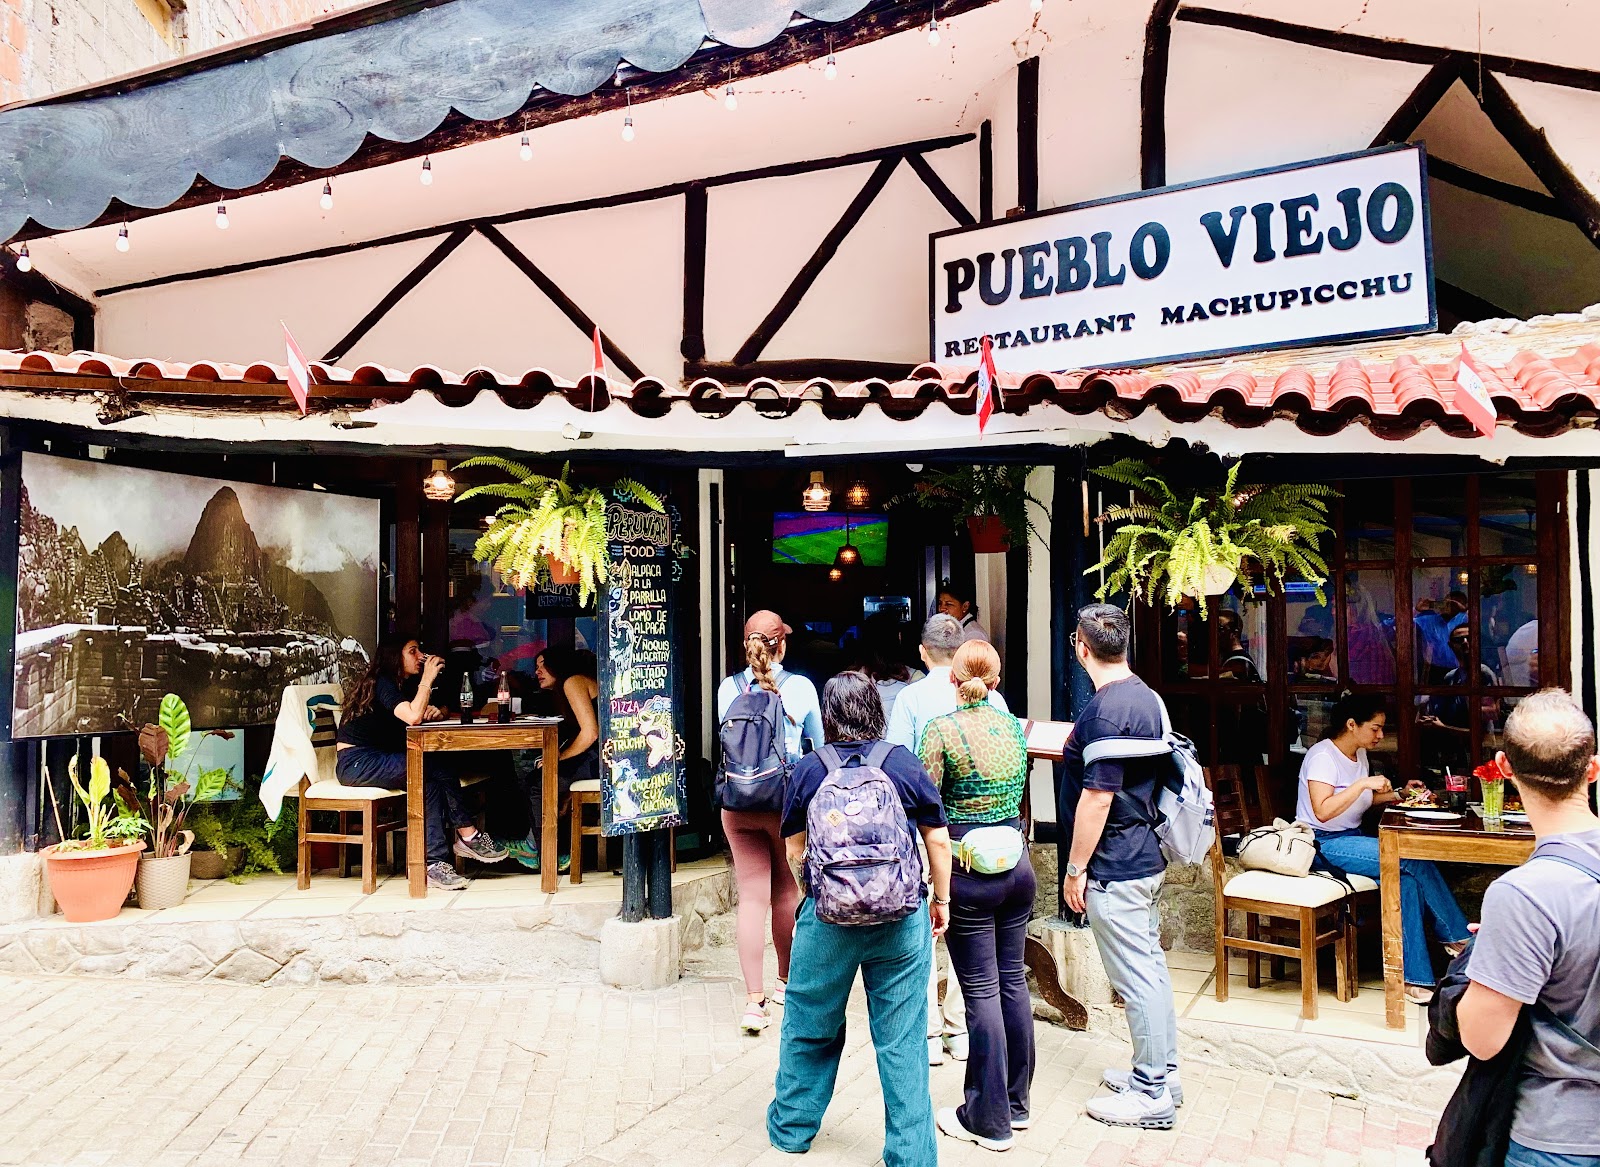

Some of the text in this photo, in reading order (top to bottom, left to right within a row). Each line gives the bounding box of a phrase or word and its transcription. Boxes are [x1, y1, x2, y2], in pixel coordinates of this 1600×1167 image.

[943, 182, 1415, 313] PUEBLO VIEJO
[944, 273, 1413, 358] RESTAURANT MACHUPICCHU
[607, 505, 669, 545] PERUVIAN
[623, 545, 655, 557] FOOD
[632, 564, 662, 577] ALPACA
[634, 578, 652, 588] A LA
[630, 589, 667, 604] PARRILLA
[629, 610, 668, 622] LOMO DE
[635, 622, 666, 635] ALPACA
[633, 650, 671, 663] HUACATAY
[631, 667, 668, 679] SALTADO
[633, 678, 665, 691] ALPACA
[610, 700, 640, 714] PIZZA
[617, 729, 630, 739] DE
[613, 735, 646, 751] TRUCHA
[643, 787, 664, 800] CUY
